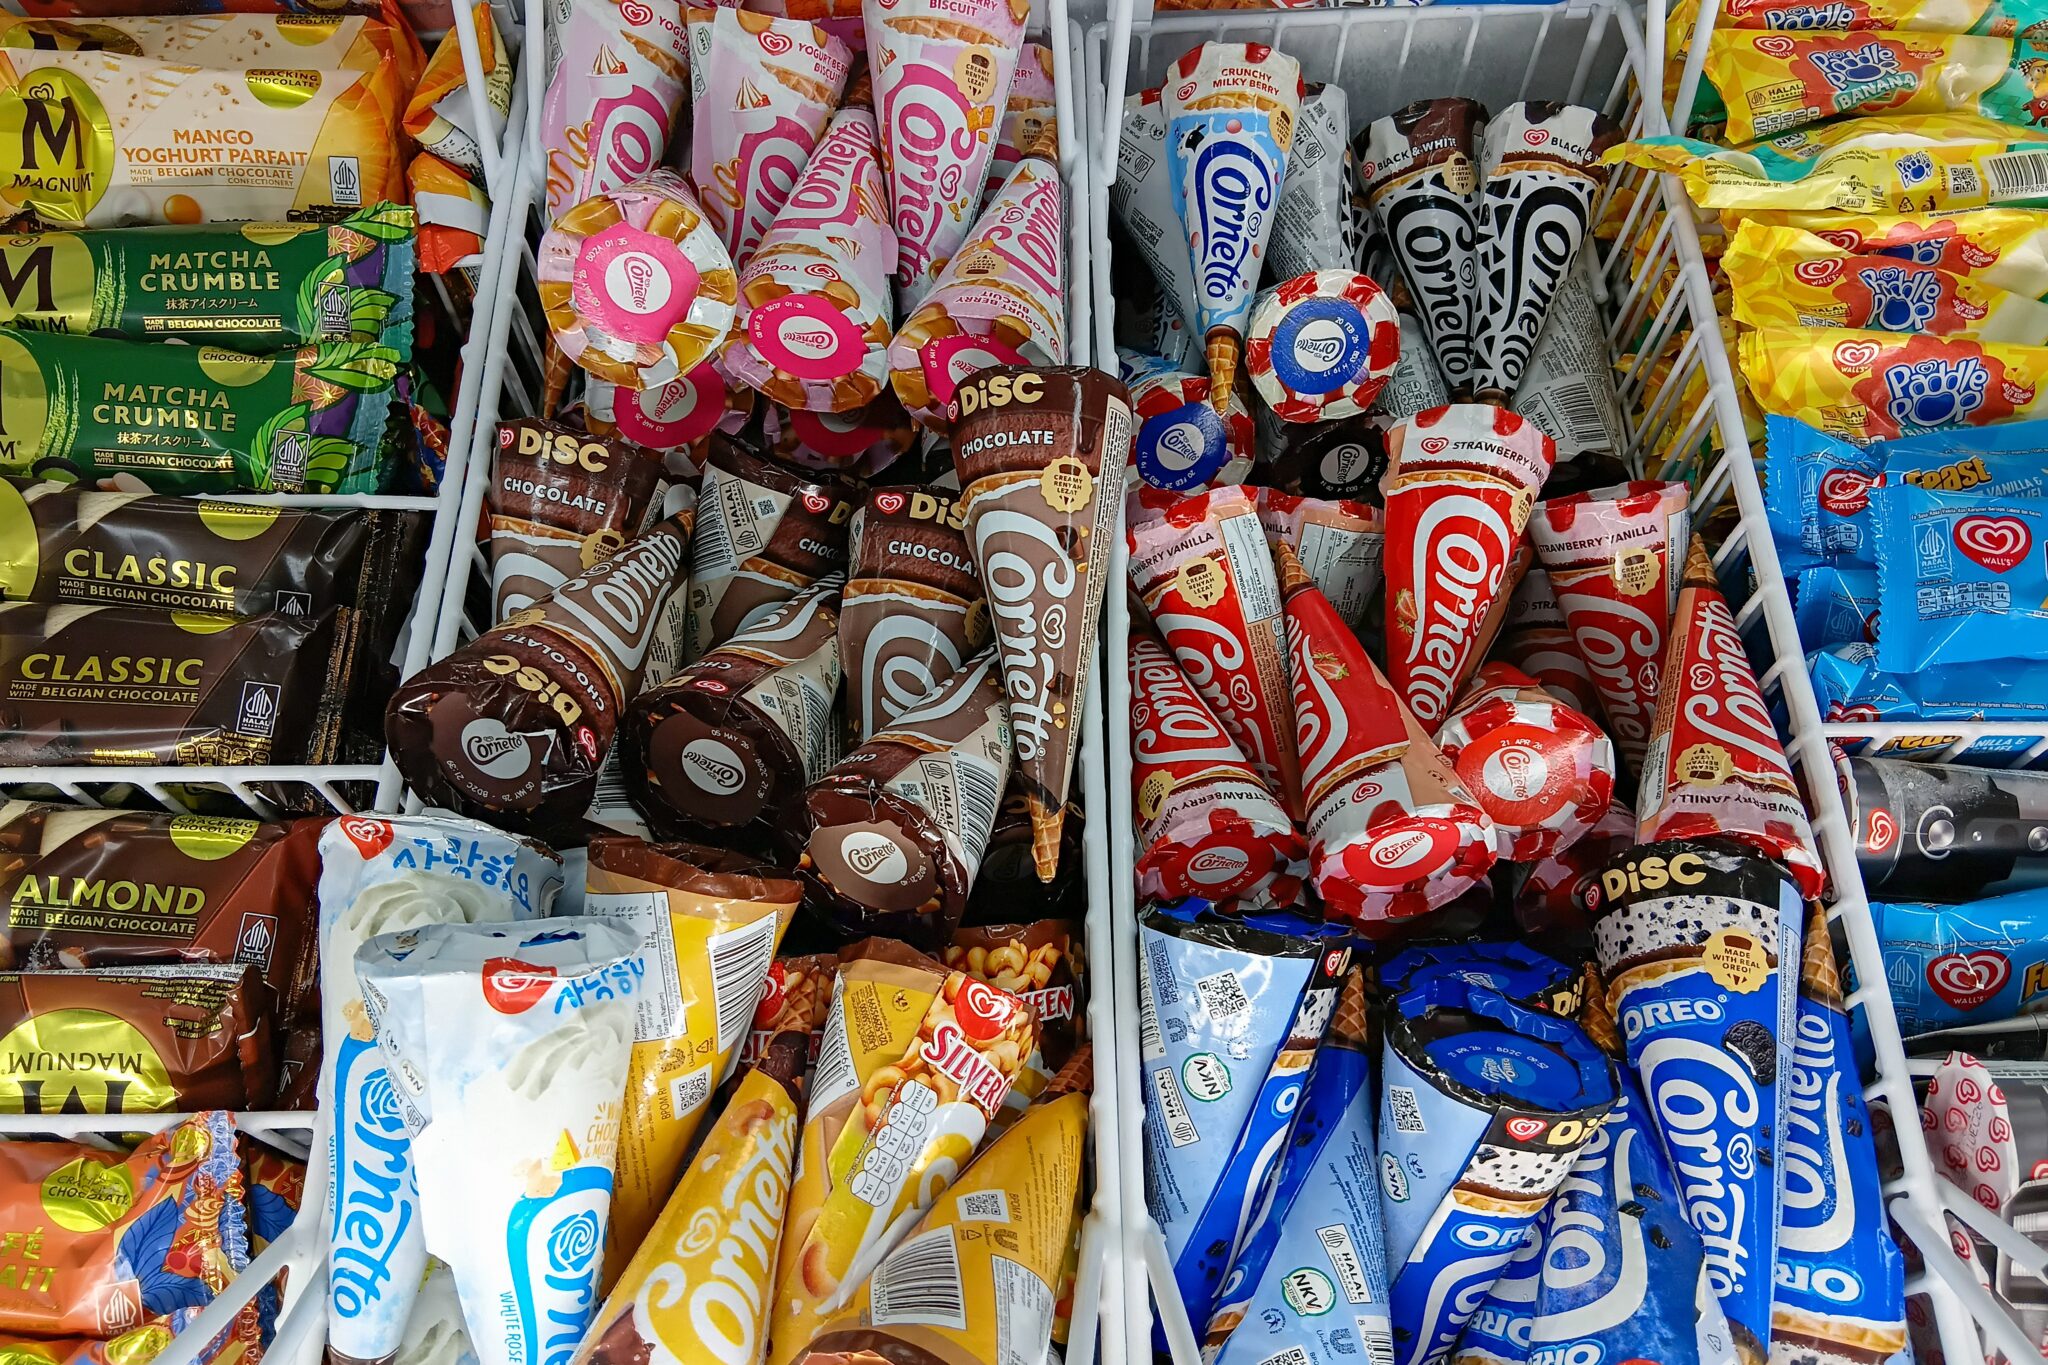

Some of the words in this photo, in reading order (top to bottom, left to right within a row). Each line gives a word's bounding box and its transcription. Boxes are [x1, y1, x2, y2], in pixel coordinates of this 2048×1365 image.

[929, 0, 978, 17] BISCUIT
[798, 42, 832, 65] YOGURT
[1809, 43, 1895, 75] Paddle
[965, 63, 990, 77] CREAMY
[1221, 68, 1272, 82] CRUNCHY
[248, 77, 315, 88] CHOCOLATE
[1212, 78, 1247, 89] MILKY
[1249, 80, 1280, 96] BERRY
[1768, 84, 1803, 96] HALAL
[1838, 73, 1918, 110] BANANA
[173, 129, 253, 145] MANGO
[1775, 135, 1803, 149] NKV
[122, 147, 225, 163] YOGHURT
[230, 149, 307, 166] PARFAIT
[1377, 150, 1409, 171] BLACK
[1411, 145, 1422, 158] &
[1422, 136, 1457, 153] WHITE
[1550, 136, 1584, 158] BLACK
[1584, 150, 1594, 162] &
[10, 173, 91, 193] MAGNUM
[157, 167, 213, 178] BELGIAN
[218, 168, 293, 179] CHOCOLATE
[227, 177, 294, 186] CONFECTIONERY
[334, 189, 357, 197] HALAL
[1195, 140, 1271, 300] Cornetto
[150, 251, 272, 269] MATCHA
[140, 273, 281, 292] CRUMBLE
[624, 256, 653, 309] Cornetto
[1386, 194, 1476, 376] Cornetto
[1500, 186, 1587, 382] Cornetto
[1811, 273, 1836, 286] WALL'S
[165, 297, 258, 309] 抹茶アイスクリーム
[955, 295, 998, 306] BERRY
[980, 291, 1030, 314] BISCUIT
[167, 318, 213, 329] BELGIAN
[215, 318, 281, 329] CHOCOLATE
[323, 315, 348, 323] HALAL
[1000, 303, 1047, 337] YOGURT
[783, 331, 834, 349] Cornetto
[1296, 337, 1344, 362] Cornetto
[203, 351, 268, 365] CHOCOLATE
[1840, 366, 1867, 374] WALL'S
[1887, 358, 1988, 400] Paddle
[103, 382, 230, 409] MATCHA
[959, 373, 1046, 417] DiSC
[92, 406, 236, 432] CRUMBLE
[117, 432, 210, 448] 抹茶アイスクリーム
[518, 427, 610, 472] DiSC
[961, 430, 1054, 459] CHOCOLATE
[1161, 429, 1199, 461] Cornetto
[118, 454, 166, 465] BELGIAN
[167, 457, 233, 470] CHOCOLATE
[1452, 441, 1529, 469] STRAWBERRY
[277, 464, 303, 472] HALAL
[1053, 474, 1083, 484] CREAMY
[504, 477, 606, 516] CHOCOLATE
[1053, 481, 1082, 490] RENYAH
[1056, 487, 1077, 495] LEZAT
[1986, 478, 2033, 498] VANILLA
[2034, 475, 2043, 486] &
[732, 484, 742, 528] HALAL
[1828, 502, 1862, 510] WALL'S
[1166, 532, 1215, 557] VANILLA
[64, 548, 237, 593] CLASSIC
[1621, 563, 1651, 574] CREAMY
[1982, 556, 2012, 566] WALL'S
[59, 580, 85, 589] MADE
[1185, 571, 1213, 586] CREAMY
[1193, 584, 1214, 594] LEZAT
[59, 587, 84, 596] WITH
[89, 584, 146, 601] BELGIAN
[150, 593, 234, 611] CHOCOLATE
[552, 533, 682, 671] Cornetto
[1406, 495, 1511, 722] Cornetto
[976, 510, 1076, 762] Cornetto
[21, 654, 204, 685] CLASSIC
[501, 633, 605, 712] CHOCOLATE
[9, 689, 34, 698] WITH
[11, 683, 37, 691] MADE
[41, 687, 103, 699] BELGIAN
[108, 689, 199, 702] CHOCOLATE
[483, 654, 582, 727] DiSC
[242, 717, 270, 726] HALAL
[467, 735, 522, 765] Cornetto
[684, 751, 744, 788] Cornetto
[1499, 748, 1530, 798] Cornetto
[171, 824, 250, 836] CHOCOLATE
[178, 816, 253, 828] CRACKING
[848, 842, 895, 875] Cornetto
[1374, 832, 1426, 865] Cornetto
[1189, 853, 1248, 871] Cornetto
[1601, 853, 1707, 902] DiSC
[10, 875, 206, 916] ALMOND
[9, 916, 38, 925] WITH
[10, 909, 39, 917] MADE
[45, 912, 104, 927] BELGIAN
[108, 918, 196, 934] CHOCOLATE
[239, 952, 266, 961] HALAL
[1711, 953, 1738, 964] WITH
[1738, 958, 1761, 969] REAL
[1723, 948, 1751, 958] MADE
[1953, 996, 1984, 1005] WALL'S
[1623, 999, 1721, 1041] OREO
[9, 1052, 142, 1074] MAGNUM
[1193, 1060, 1221, 1095] NKV
[1158, 1072, 1177, 1118] HALAL
[1386, 1161, 1401, 1197] NKV
[1639, 1038, 1760, 1299] Cornetto
[1341, 1252, 1365, 1300] HALAL
[1293, 1274, 1322, 1310] NKV
[500, 1292, 518, 1330] WHITE
[508, 1331, 522, 1364] ROSE
